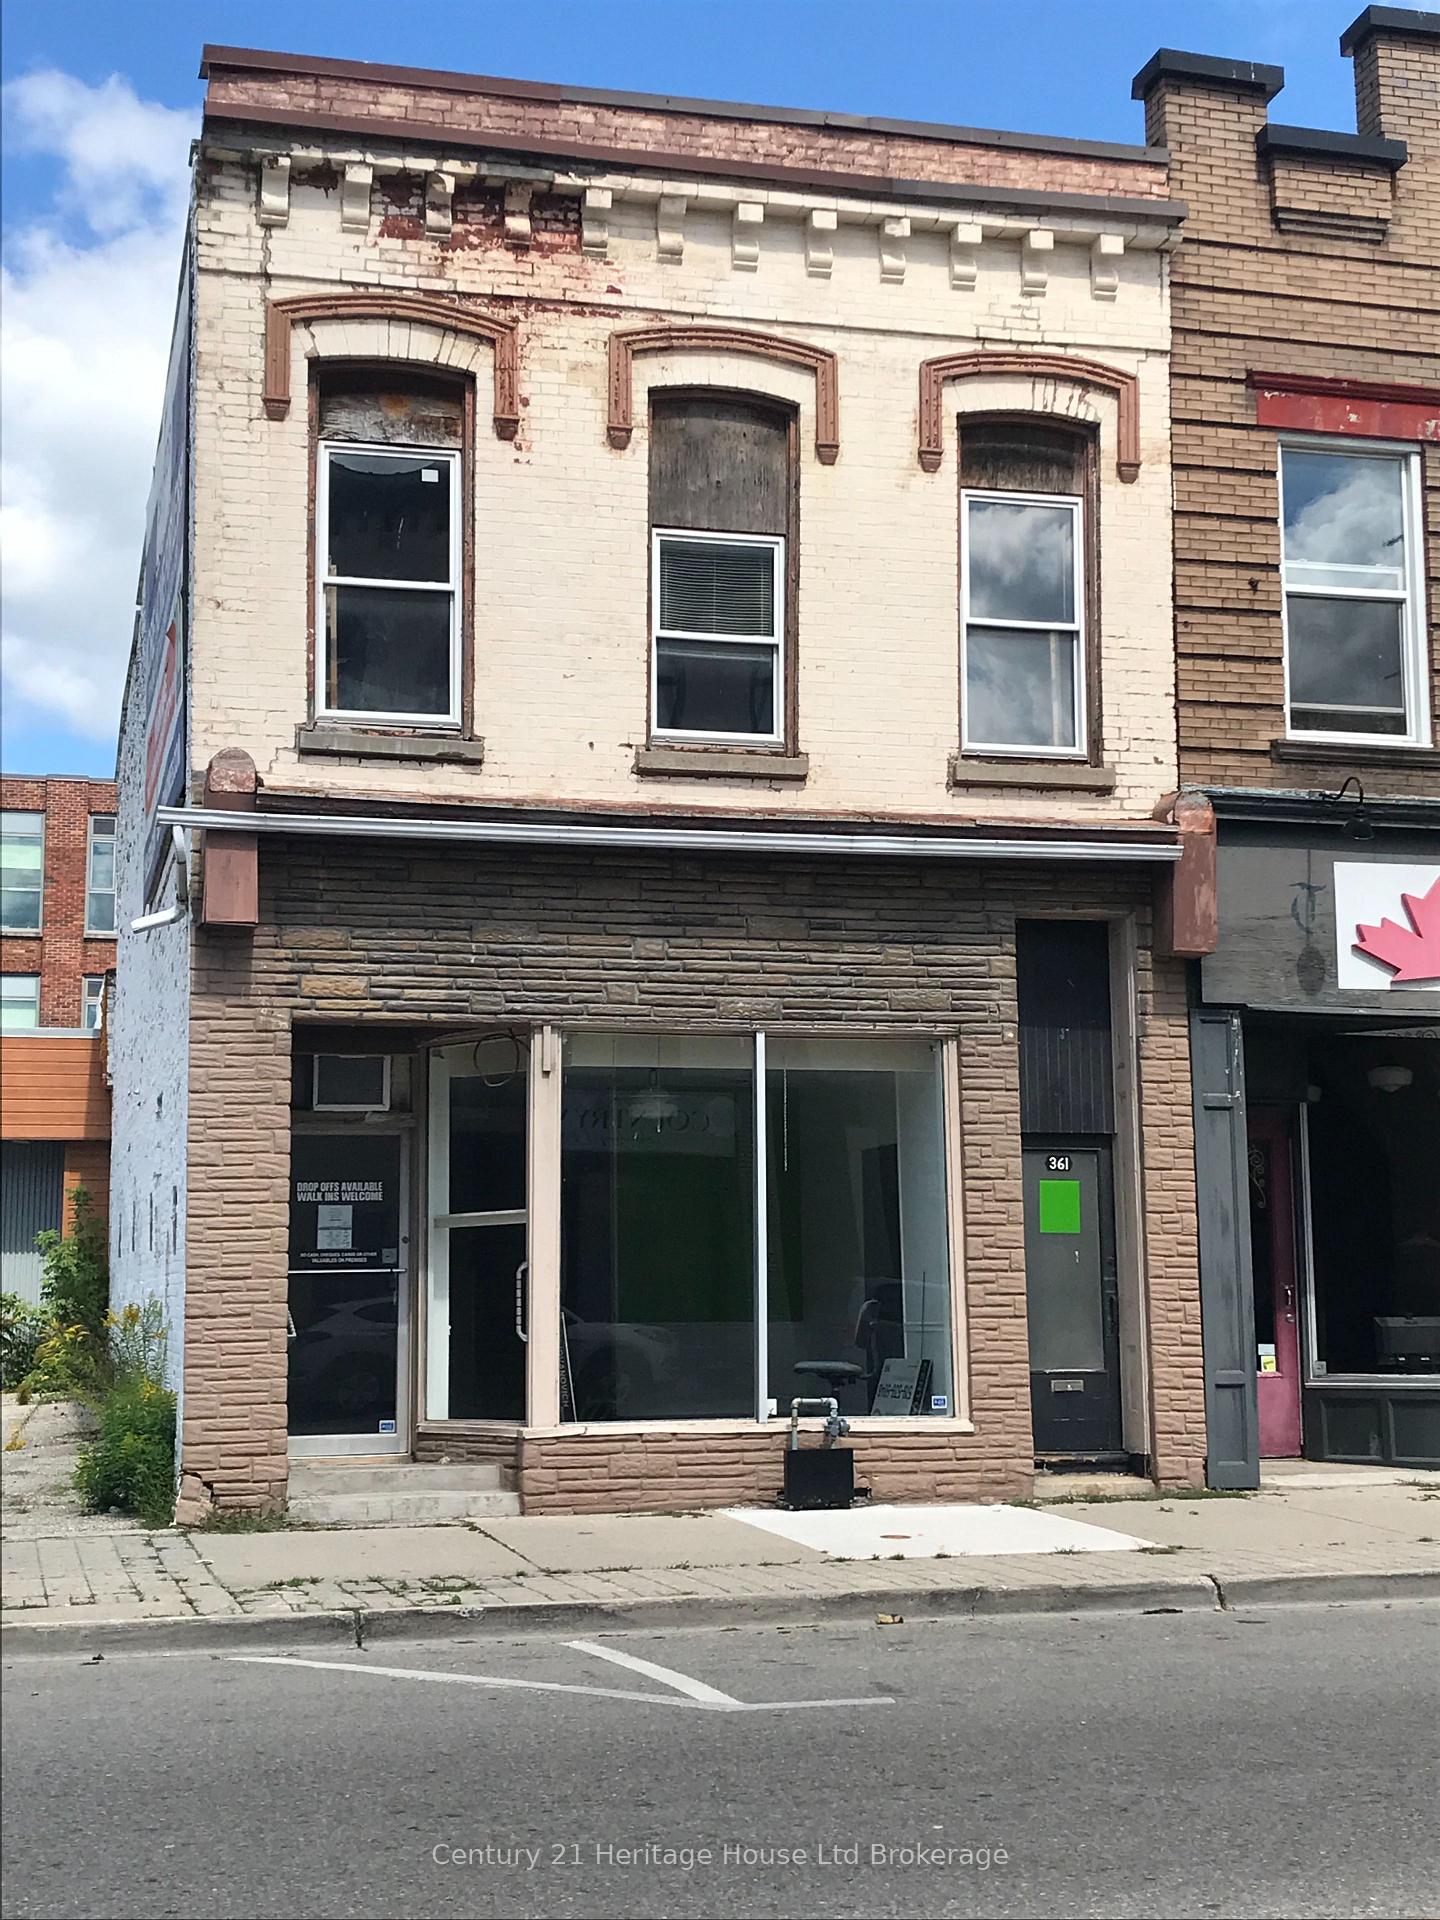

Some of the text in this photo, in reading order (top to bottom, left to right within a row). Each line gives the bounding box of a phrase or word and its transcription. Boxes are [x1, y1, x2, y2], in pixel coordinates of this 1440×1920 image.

[1049, 1157, 1069, 1170] 361
[297, 1182, 383, 1192] DROP OFFS AVAILABLE
[297, 1191, 383, 1201] WALK INS WELCOME
